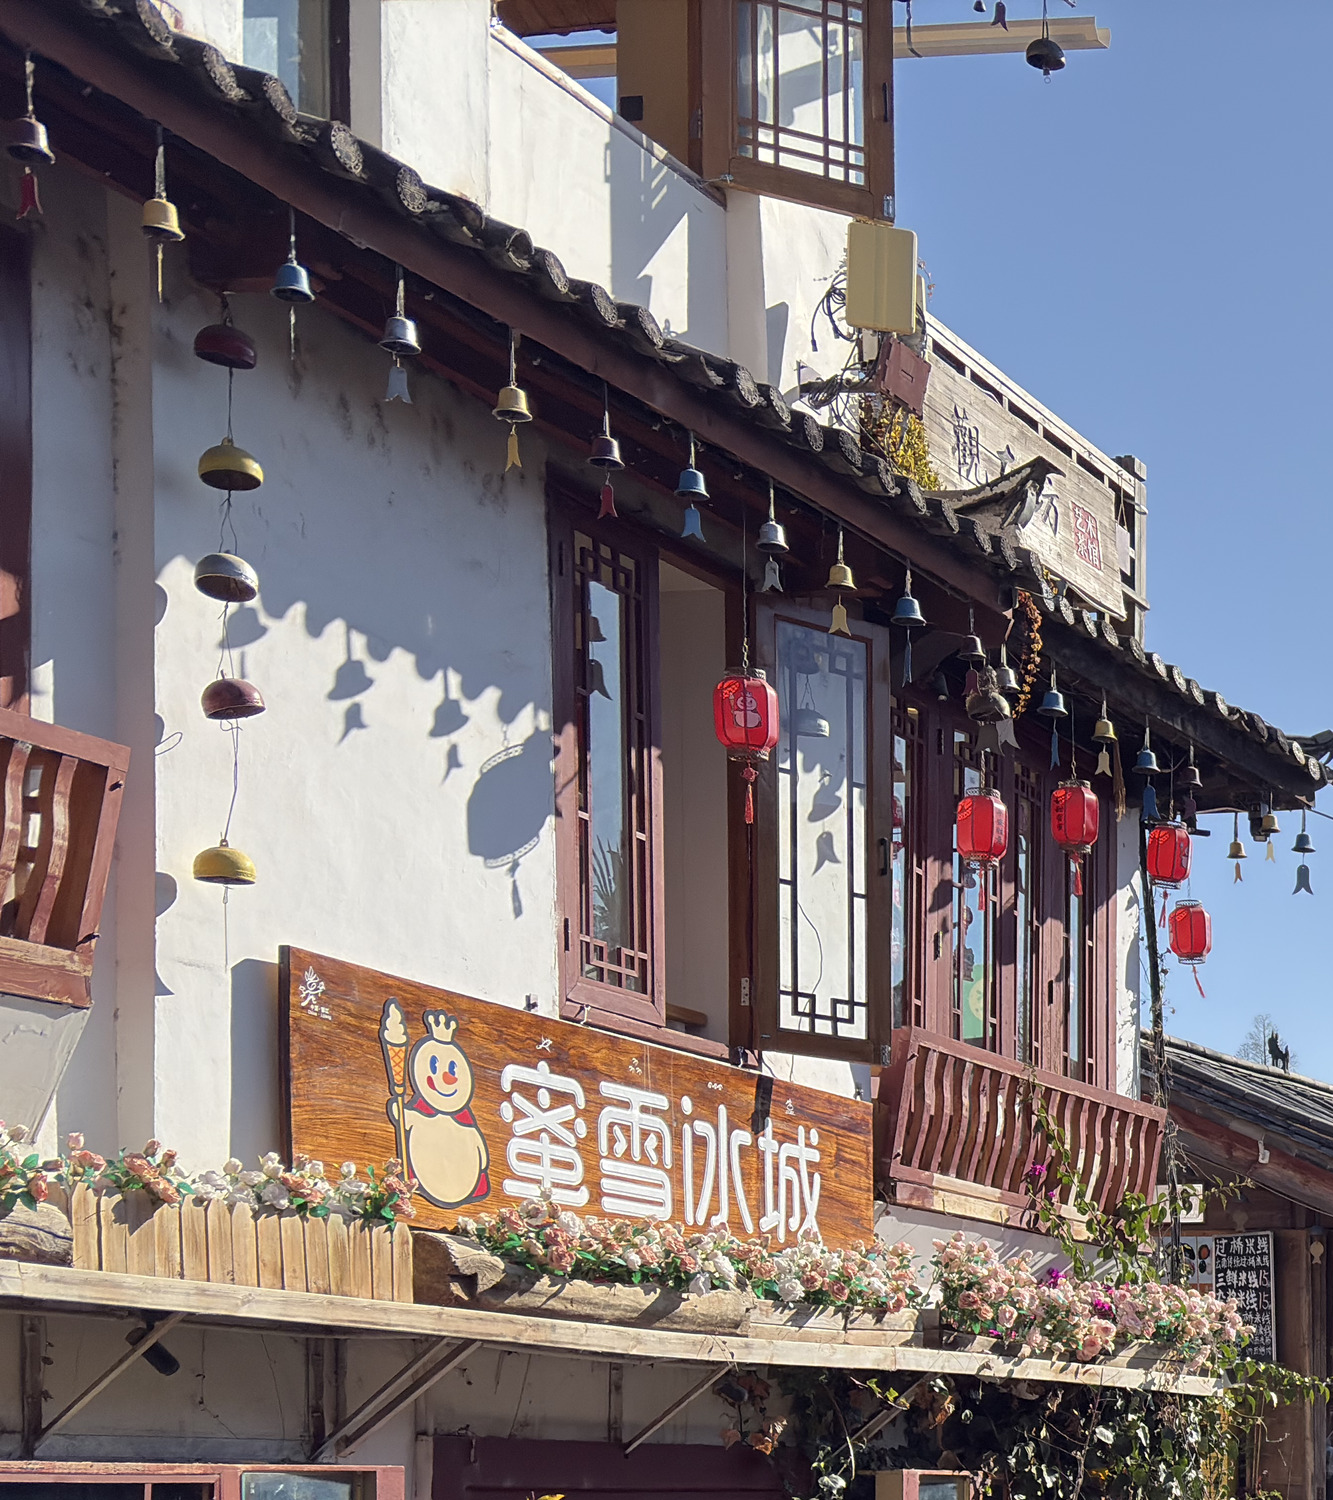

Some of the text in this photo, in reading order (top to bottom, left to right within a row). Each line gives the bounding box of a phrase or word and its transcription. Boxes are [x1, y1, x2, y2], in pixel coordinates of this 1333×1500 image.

[501, 1060, 822, 1246] 蜜雪冰城
[1215, 1236, 1269, 1257] 过桥米线
[1216, 1270, 1259, 1290] 三鲜米线
